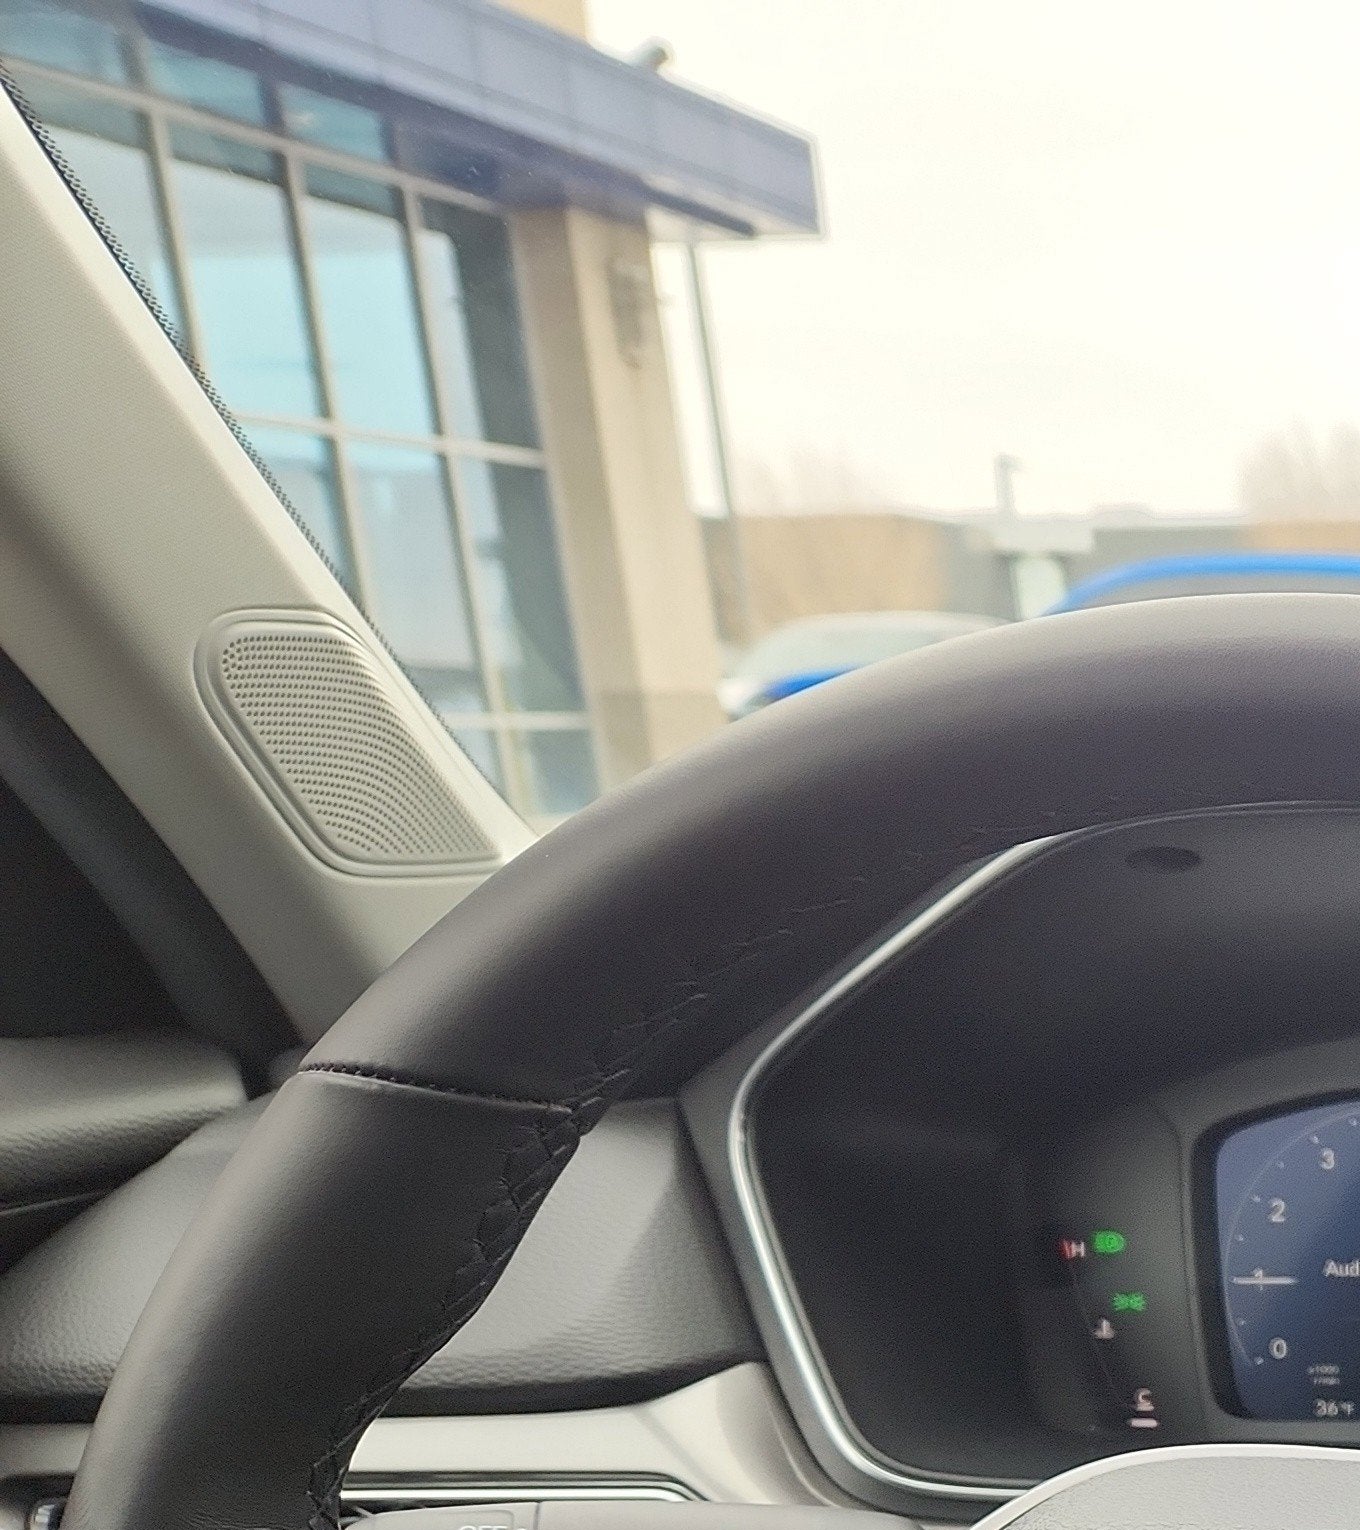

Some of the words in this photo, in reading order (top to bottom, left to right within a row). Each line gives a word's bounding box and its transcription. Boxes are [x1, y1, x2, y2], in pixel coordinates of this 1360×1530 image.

[1320, 1148, 1335, 1170] 3
[1269, 1199, 1286, 1222] 2
[1270, 1338, 1288, 1359] 0
